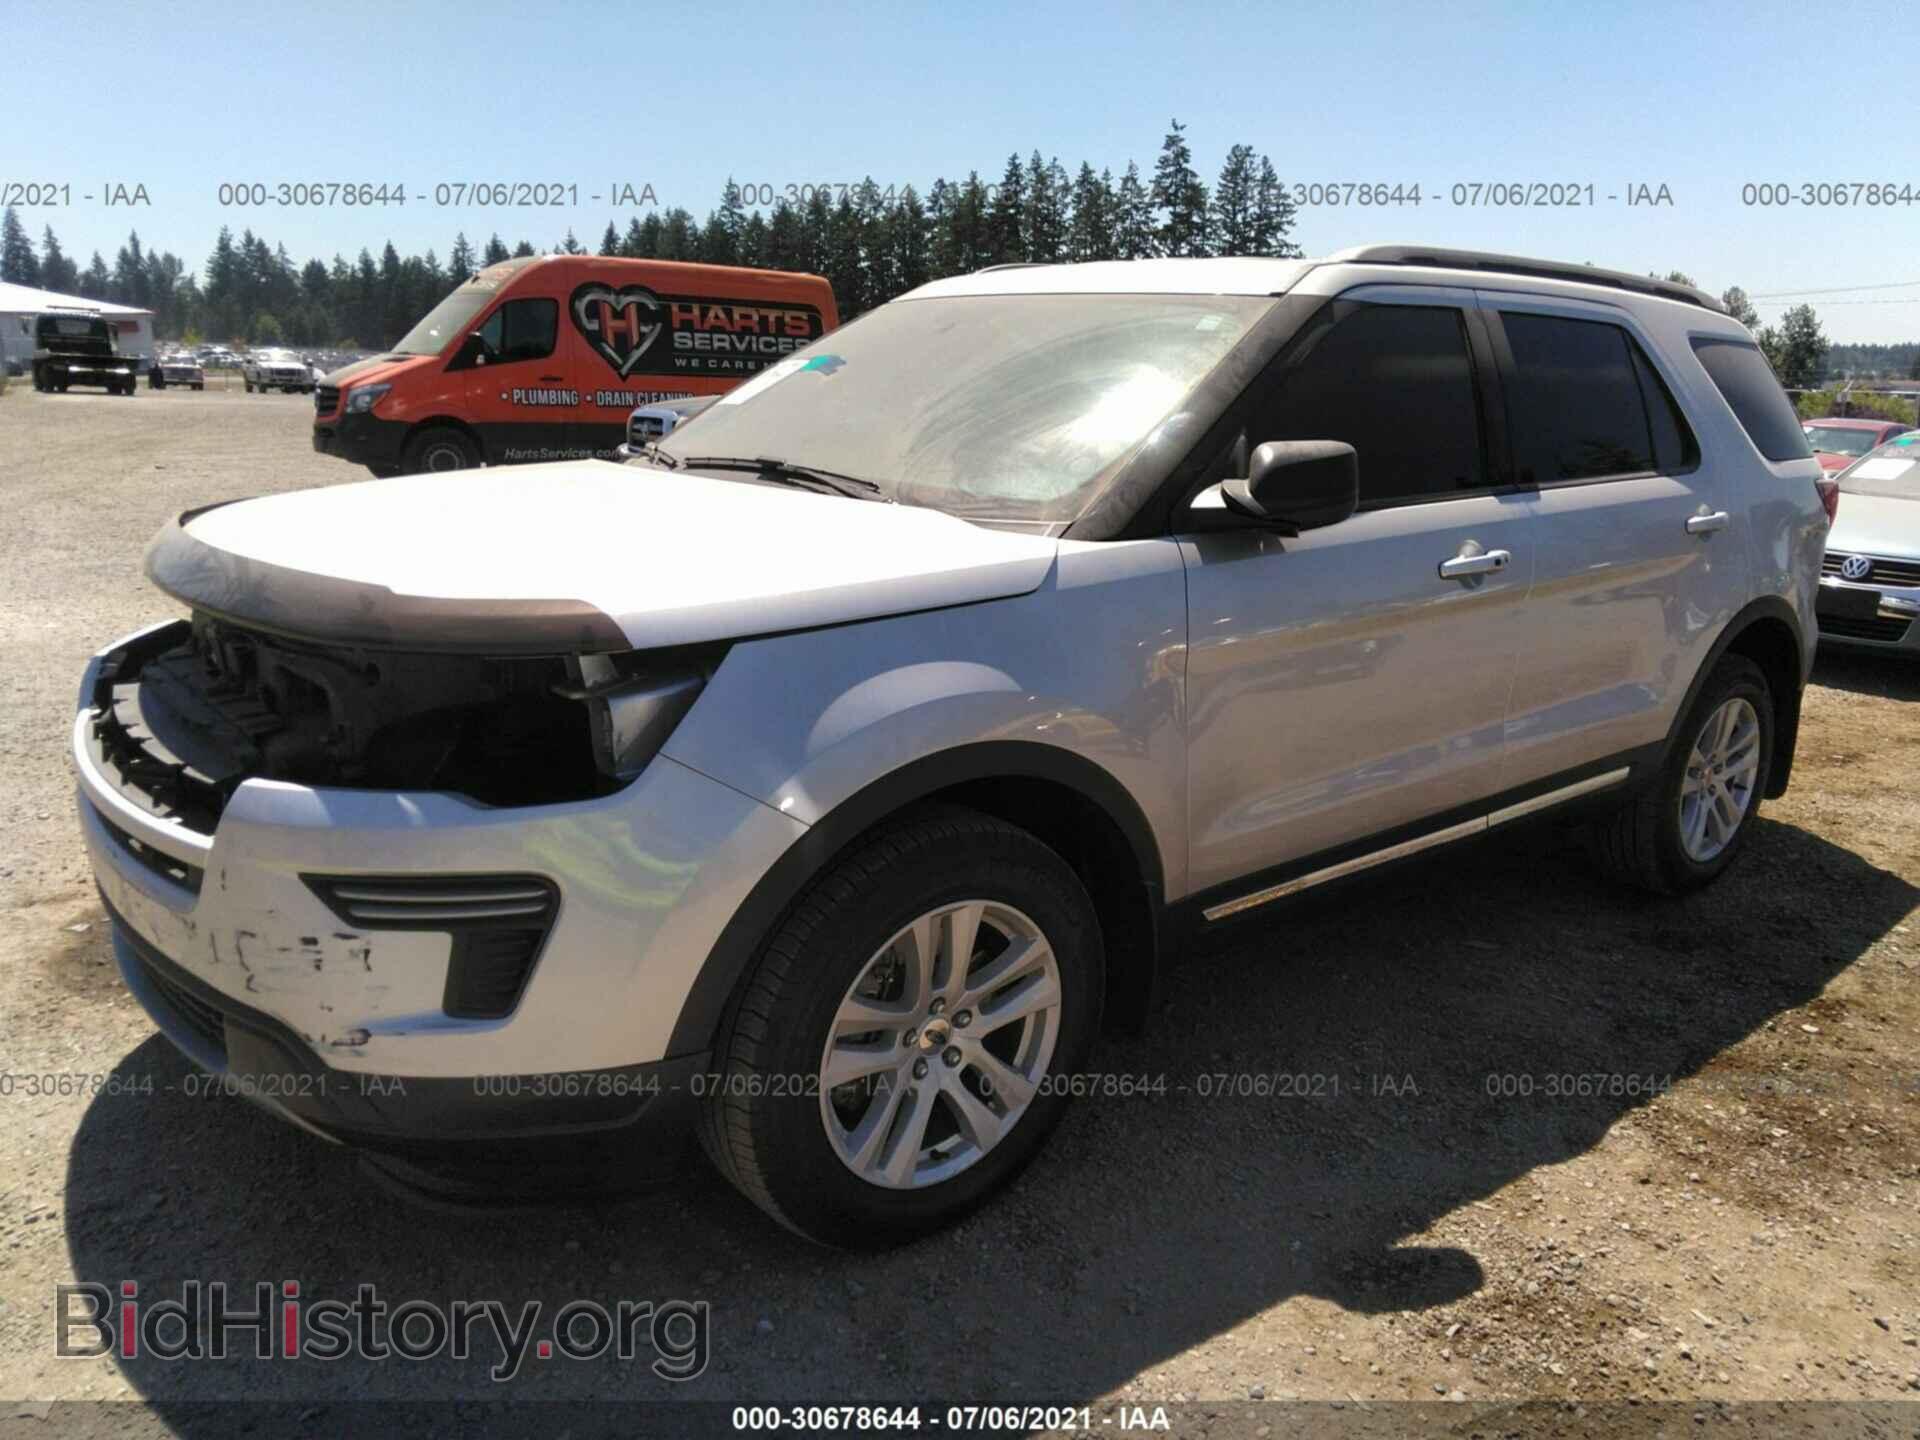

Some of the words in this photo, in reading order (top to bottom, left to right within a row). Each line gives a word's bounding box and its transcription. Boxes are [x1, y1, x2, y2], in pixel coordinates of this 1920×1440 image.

[671, 303, 811, 336] HARTS
[674, 358, 700, 368] WE
[708, 359, 755, 369] CARE
[512, 388, 579, 406] PLUMBING
[596, 390, 635, 408] DRAIN
